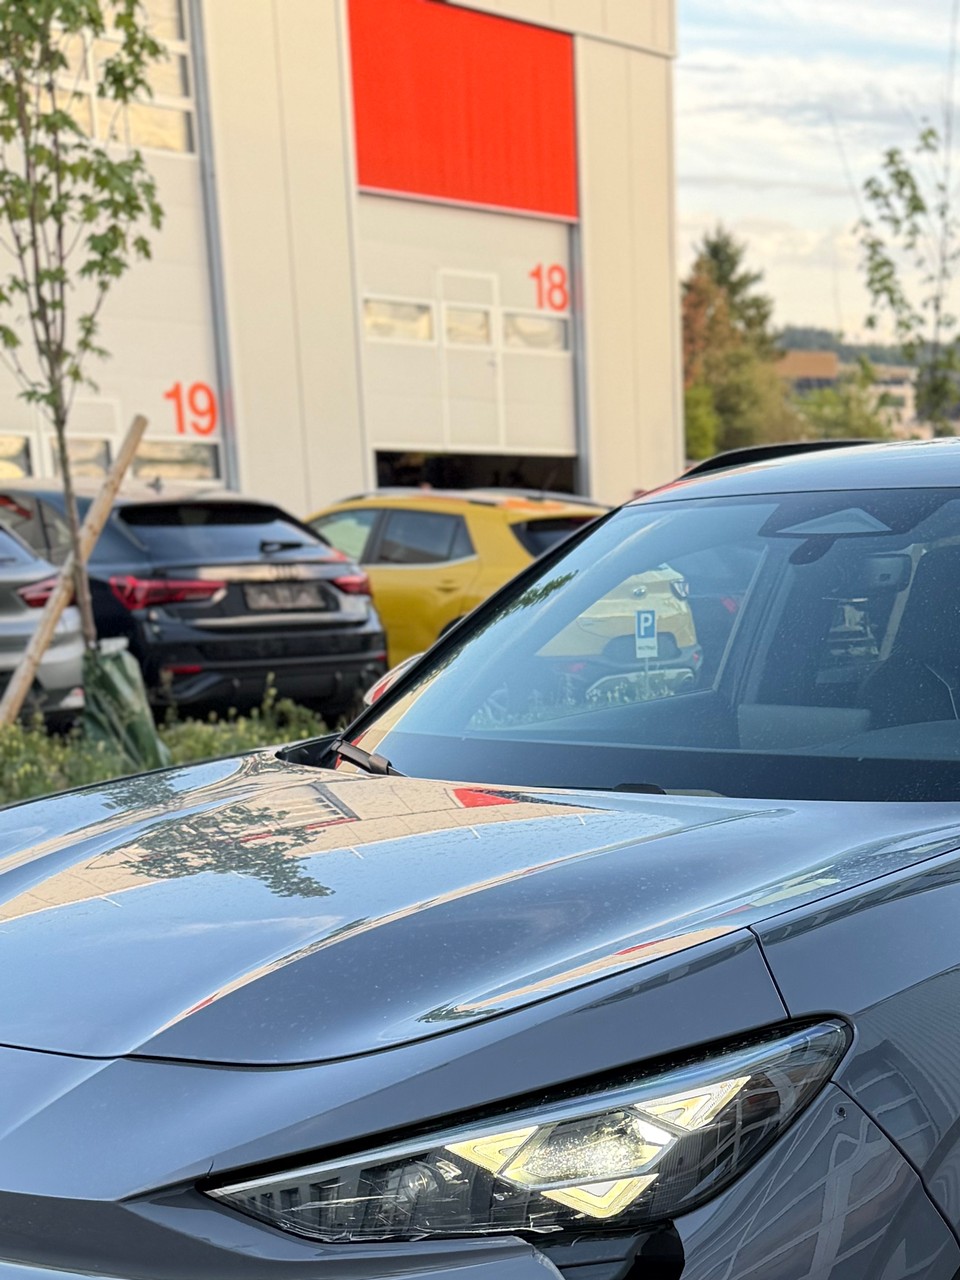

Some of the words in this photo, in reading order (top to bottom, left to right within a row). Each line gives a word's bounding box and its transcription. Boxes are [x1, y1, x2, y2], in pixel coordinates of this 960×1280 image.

[530, 264, 569, 312] 18
[164, 382, 218, 436] 19
[640, 613, 653, 636] P
